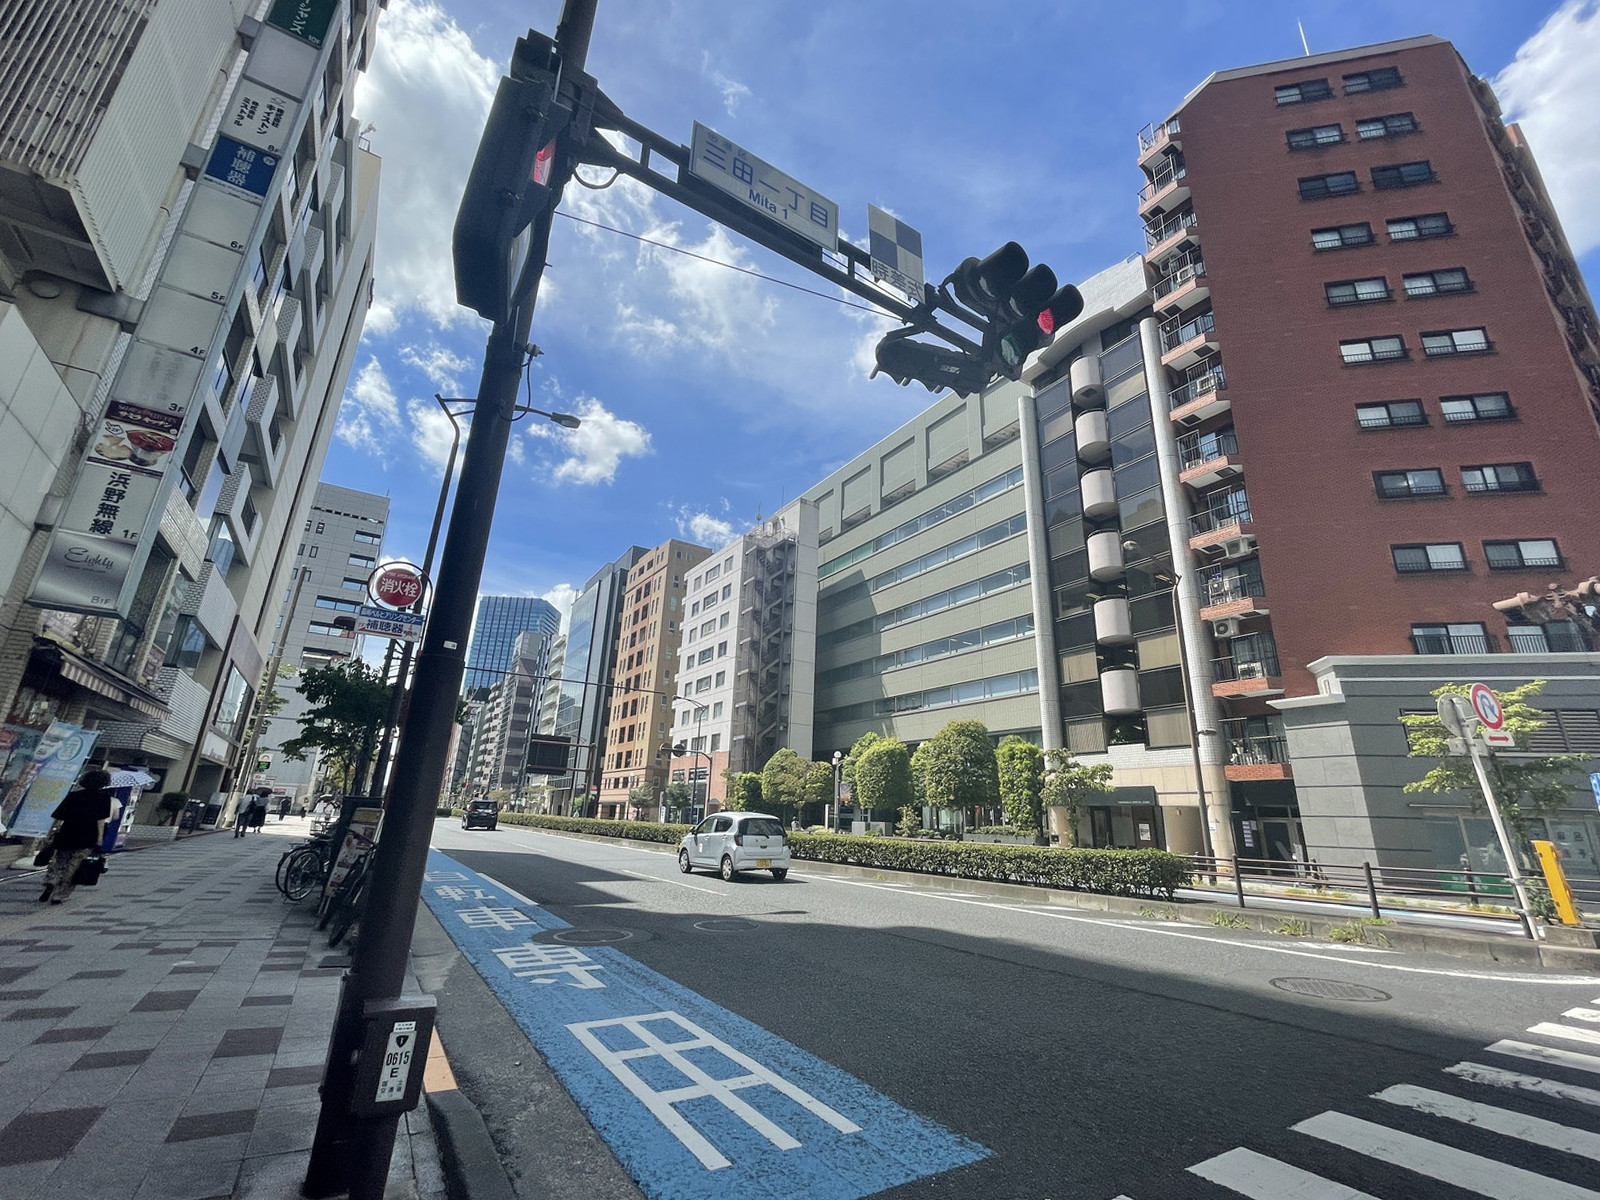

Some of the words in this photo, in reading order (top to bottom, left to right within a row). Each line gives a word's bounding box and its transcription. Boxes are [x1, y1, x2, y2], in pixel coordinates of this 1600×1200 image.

[308, 35, 320, 44] 10F
[226, 145, 257, 187] 補聴器
[703, 140, 828, 229] 三田一丁目
[749, 189, 777, 215] Mita
[782, 208, 788, 220] 1
[230, 240, 244, 251] 6F
[871, 258, 924, 303] 時差式
[210, 291, 225, 302] 5F
[190, 346, 206, 357] 4F
[168, 402, 185, 414] 3F
[88, 471, 132, 535] 浜野無線
[122, 529, 139, 540] 1F
[64, 546, 115, 570] Eighty
[380, 577, 418, 597] 消火栓
[90, 595, 112, 606] B1F
[366, 619, 404, 634] 補聴器
[386, 1050, 411, 1067] 0615
[389, 1067, 400, 1078] E
